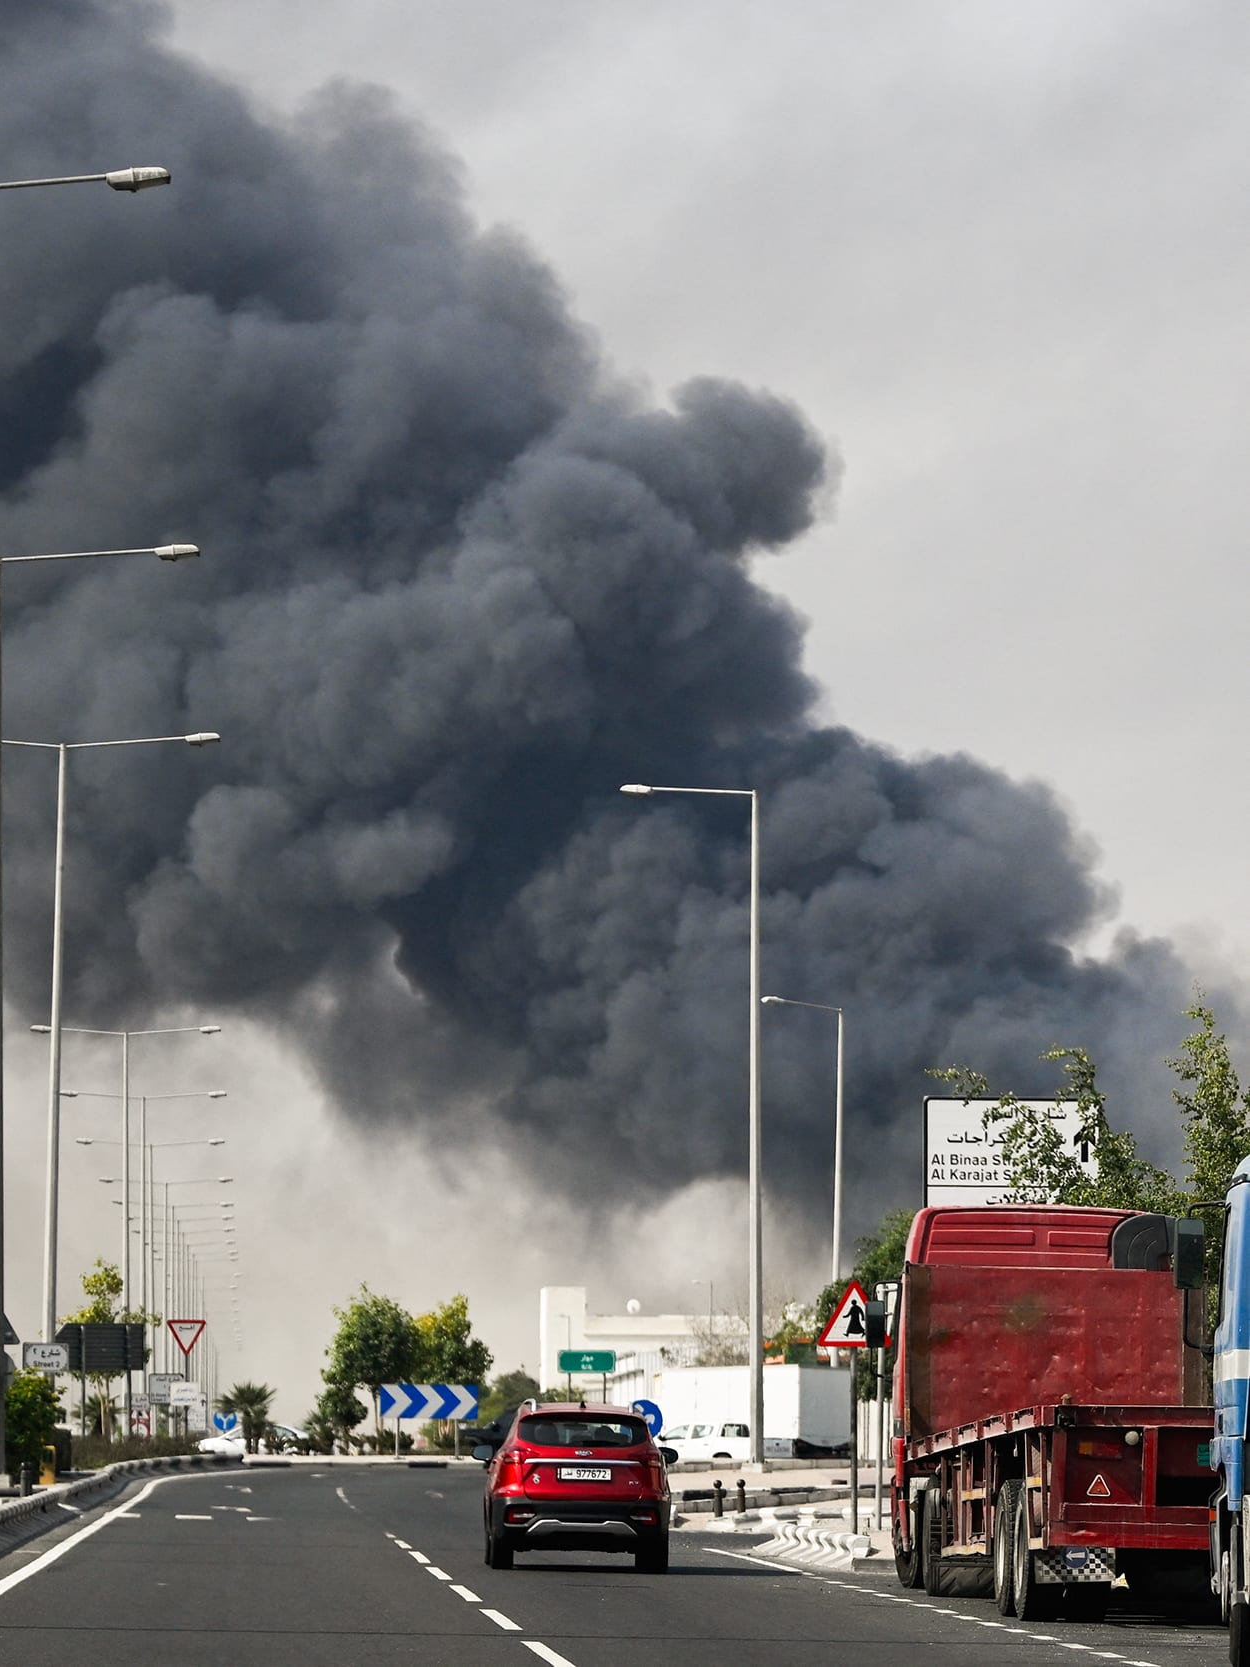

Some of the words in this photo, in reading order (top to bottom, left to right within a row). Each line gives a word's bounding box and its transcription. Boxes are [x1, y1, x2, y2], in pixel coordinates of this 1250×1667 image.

[947, 1131, 1016, 1147] كراجات
[931, 1153, 945, 1166] Al
[950, 1153, 988, 1166] Binaa
[931, 1168, 945, 1181] Al
[950, 1168, 999, 1183] Karajat
[576, 1468, 607, 1479] 977672
